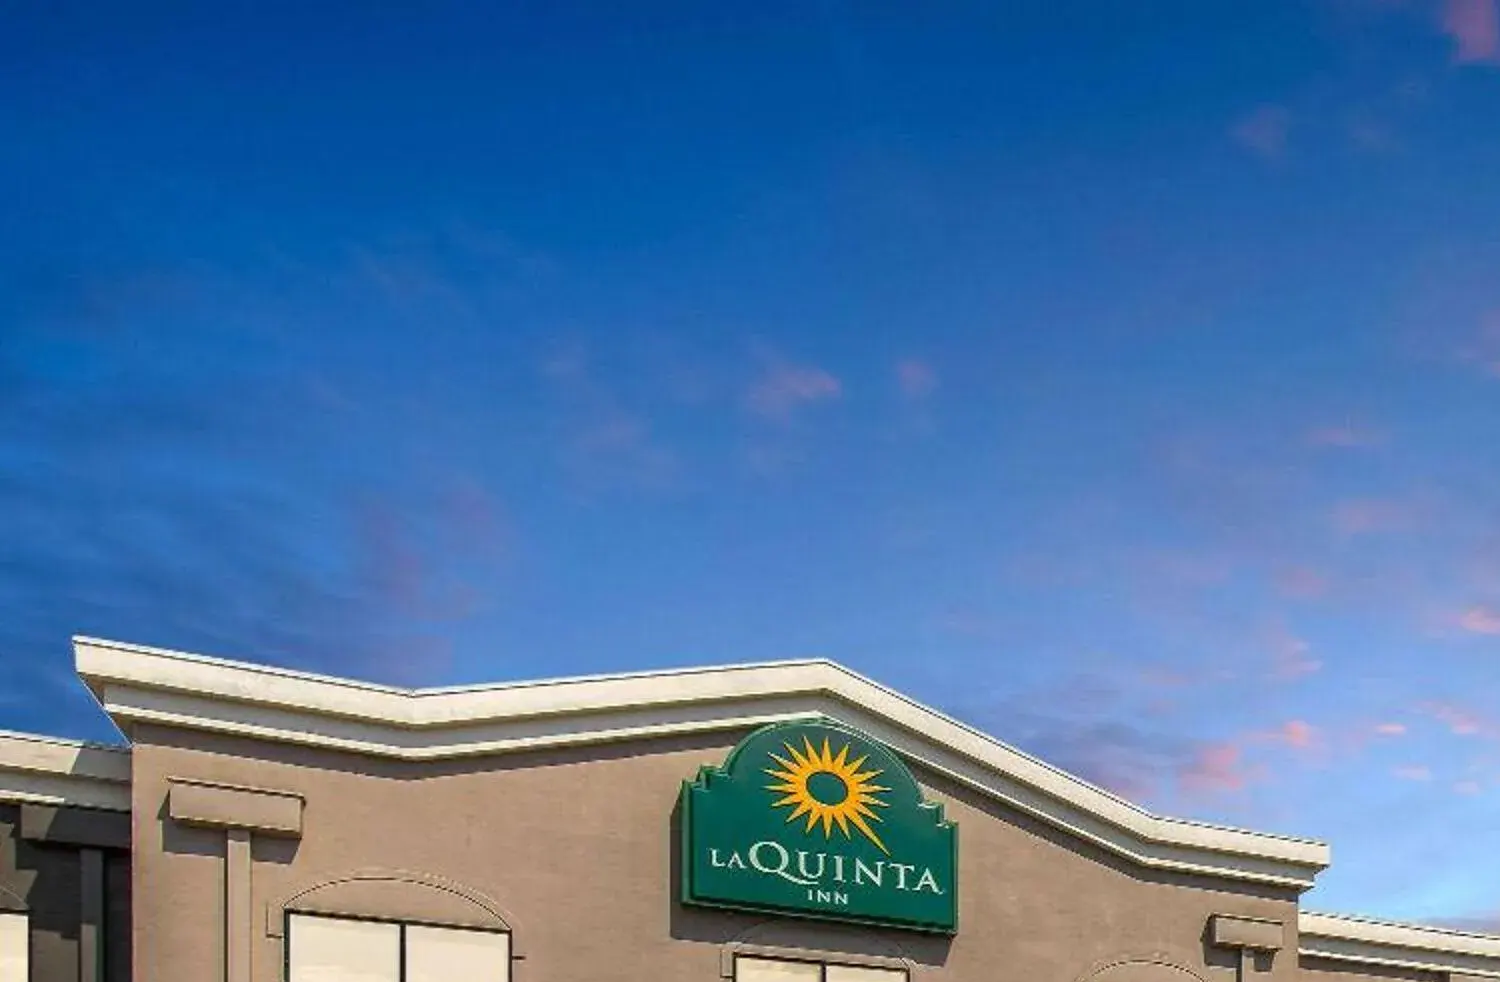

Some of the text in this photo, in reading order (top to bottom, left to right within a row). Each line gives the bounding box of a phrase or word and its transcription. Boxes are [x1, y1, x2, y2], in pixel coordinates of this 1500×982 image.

[709, 841, 945, 895] LA QUINTA
[807, 889, 848, 905] INN
